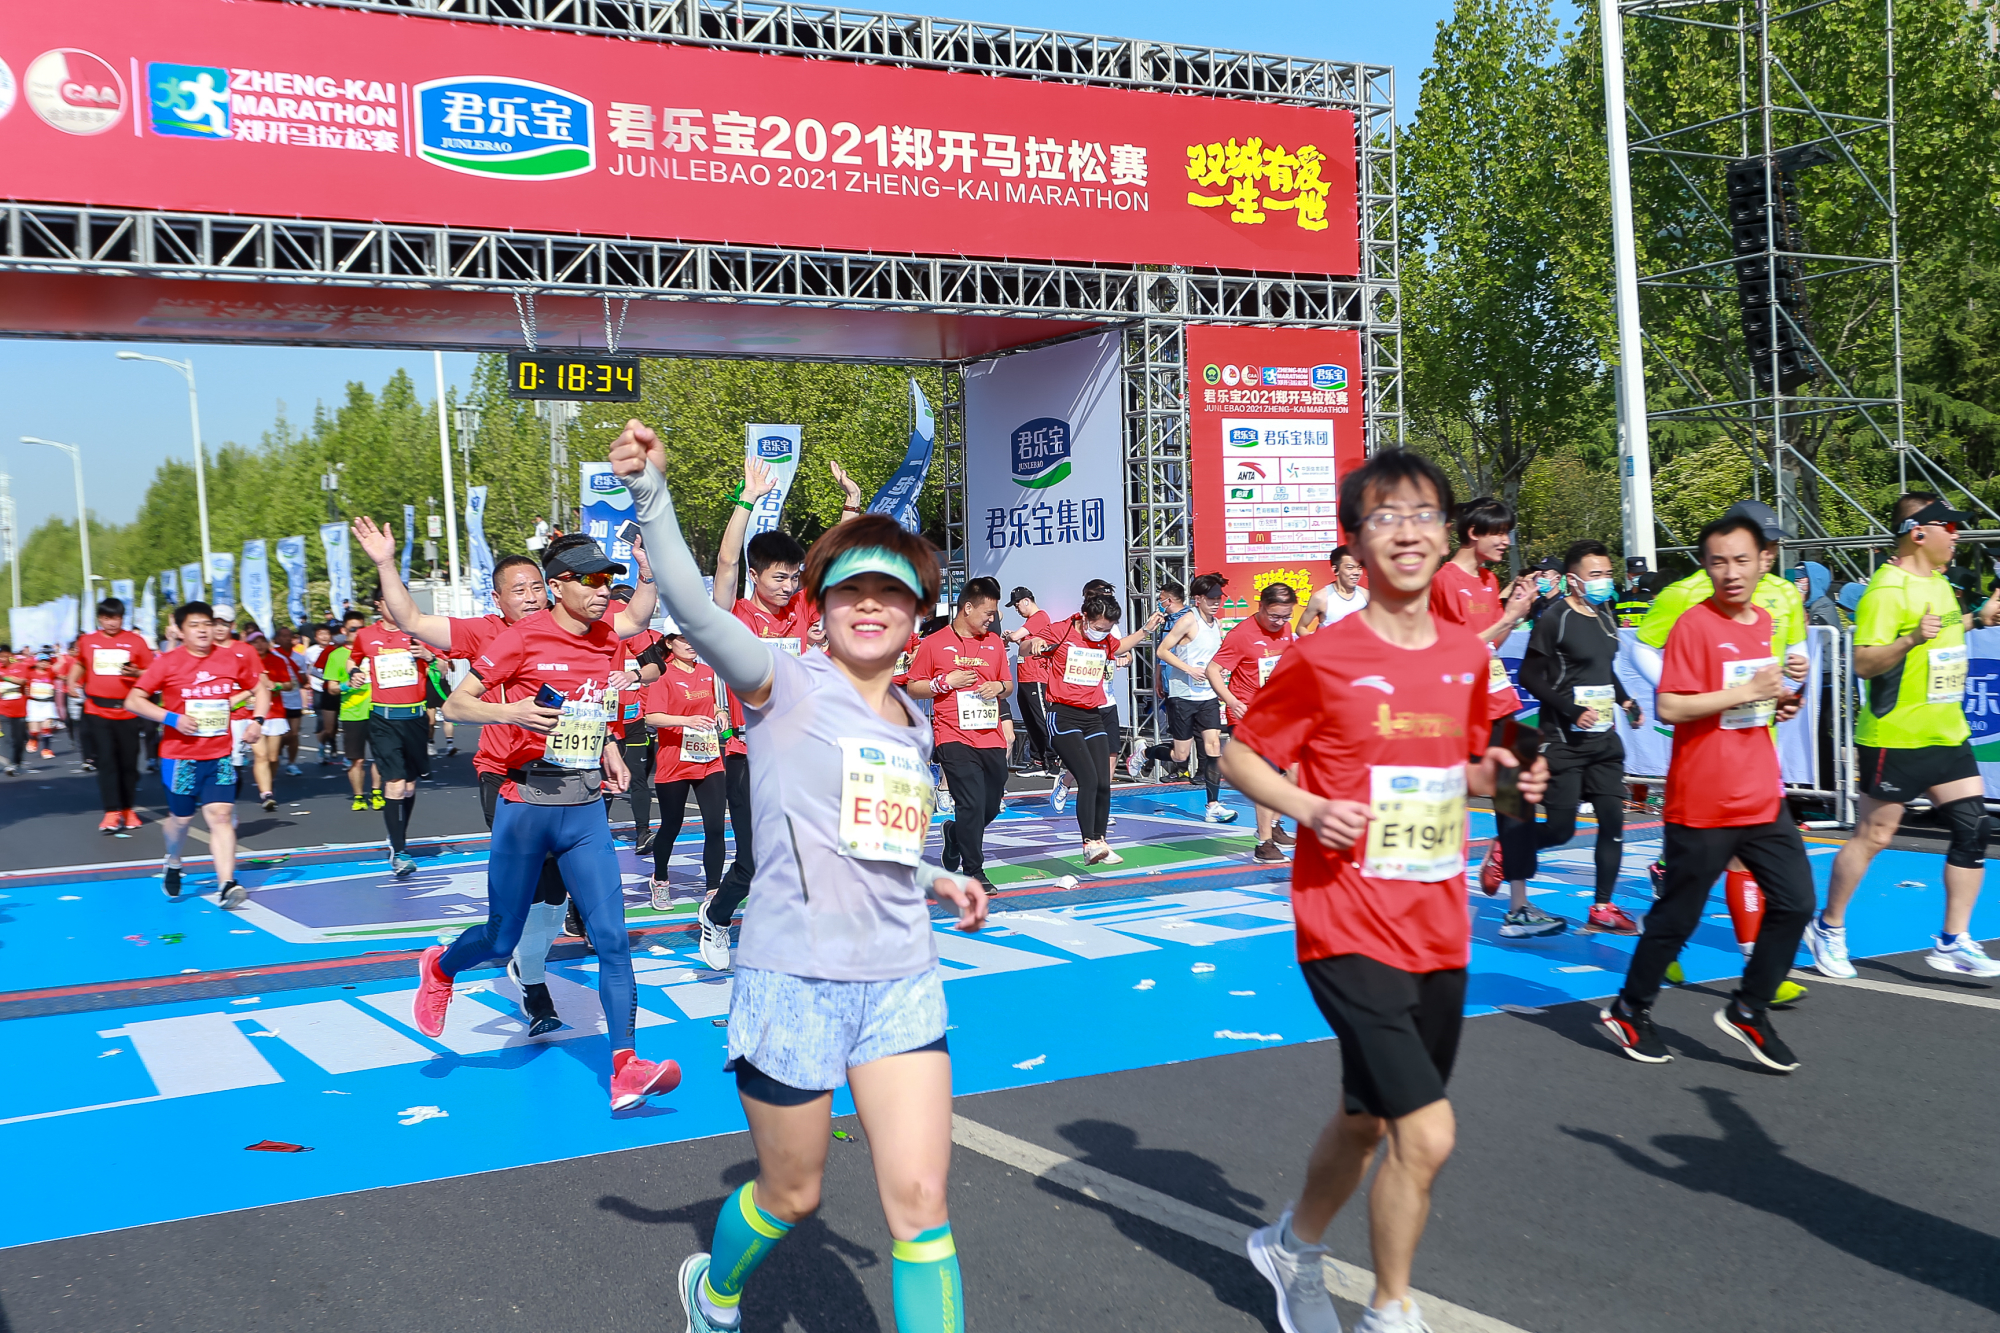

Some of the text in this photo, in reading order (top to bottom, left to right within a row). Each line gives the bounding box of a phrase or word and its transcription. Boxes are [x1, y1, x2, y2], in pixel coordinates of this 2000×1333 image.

[62, 83, 120, 104] CAA
[231, 68, 396, 104] ZHENG-KAI
[231, 94, 397, 128] MARATHON
[441, 91, 573, 141] 君乐宝
[232, 118, 399, 153] 郑开马拉松赛
[440, 137, 513, 152] JUNLEBAO
[607, 102, 1148, 187] 君乐宝2021郑开马拉松赛
[1184, 137, 1332, 196] 双城有爱
[608, 154, 1149, 212] JUNLEBAO 2021 ZHENG-KAI MARATHON
[1187, 177, 1329, 231] 一生一世
[519, 362, 633, 392] 0:18:34
[1316, 369, 1344, 380] 君乐宝
[1203, 388, 1349, 406] 君乐宝2021郑开马拉松赛
[1204, 404, 1349, 414] JUNLEBAO 2021 ZHENG-KAI MARATHON
[760, 440, 790, 452] 君乐宝
[1018, 426, 1064, 460] 君乐宝
[1232, 430, 1328, 446] 君乐宝 君乐宝集团
[1018, 460, 1044, 472] JUNLEBAO
[1237, 471, 1256, 481] ANTA
[985, 497, 1105, 549] 君乐宝集团
[380, 668, 415, 680] E20043
[1069, 665, 1102, 677] E60407
[962, 709, 997, 719] E17367
[553, 733, 602, 751] E19137
